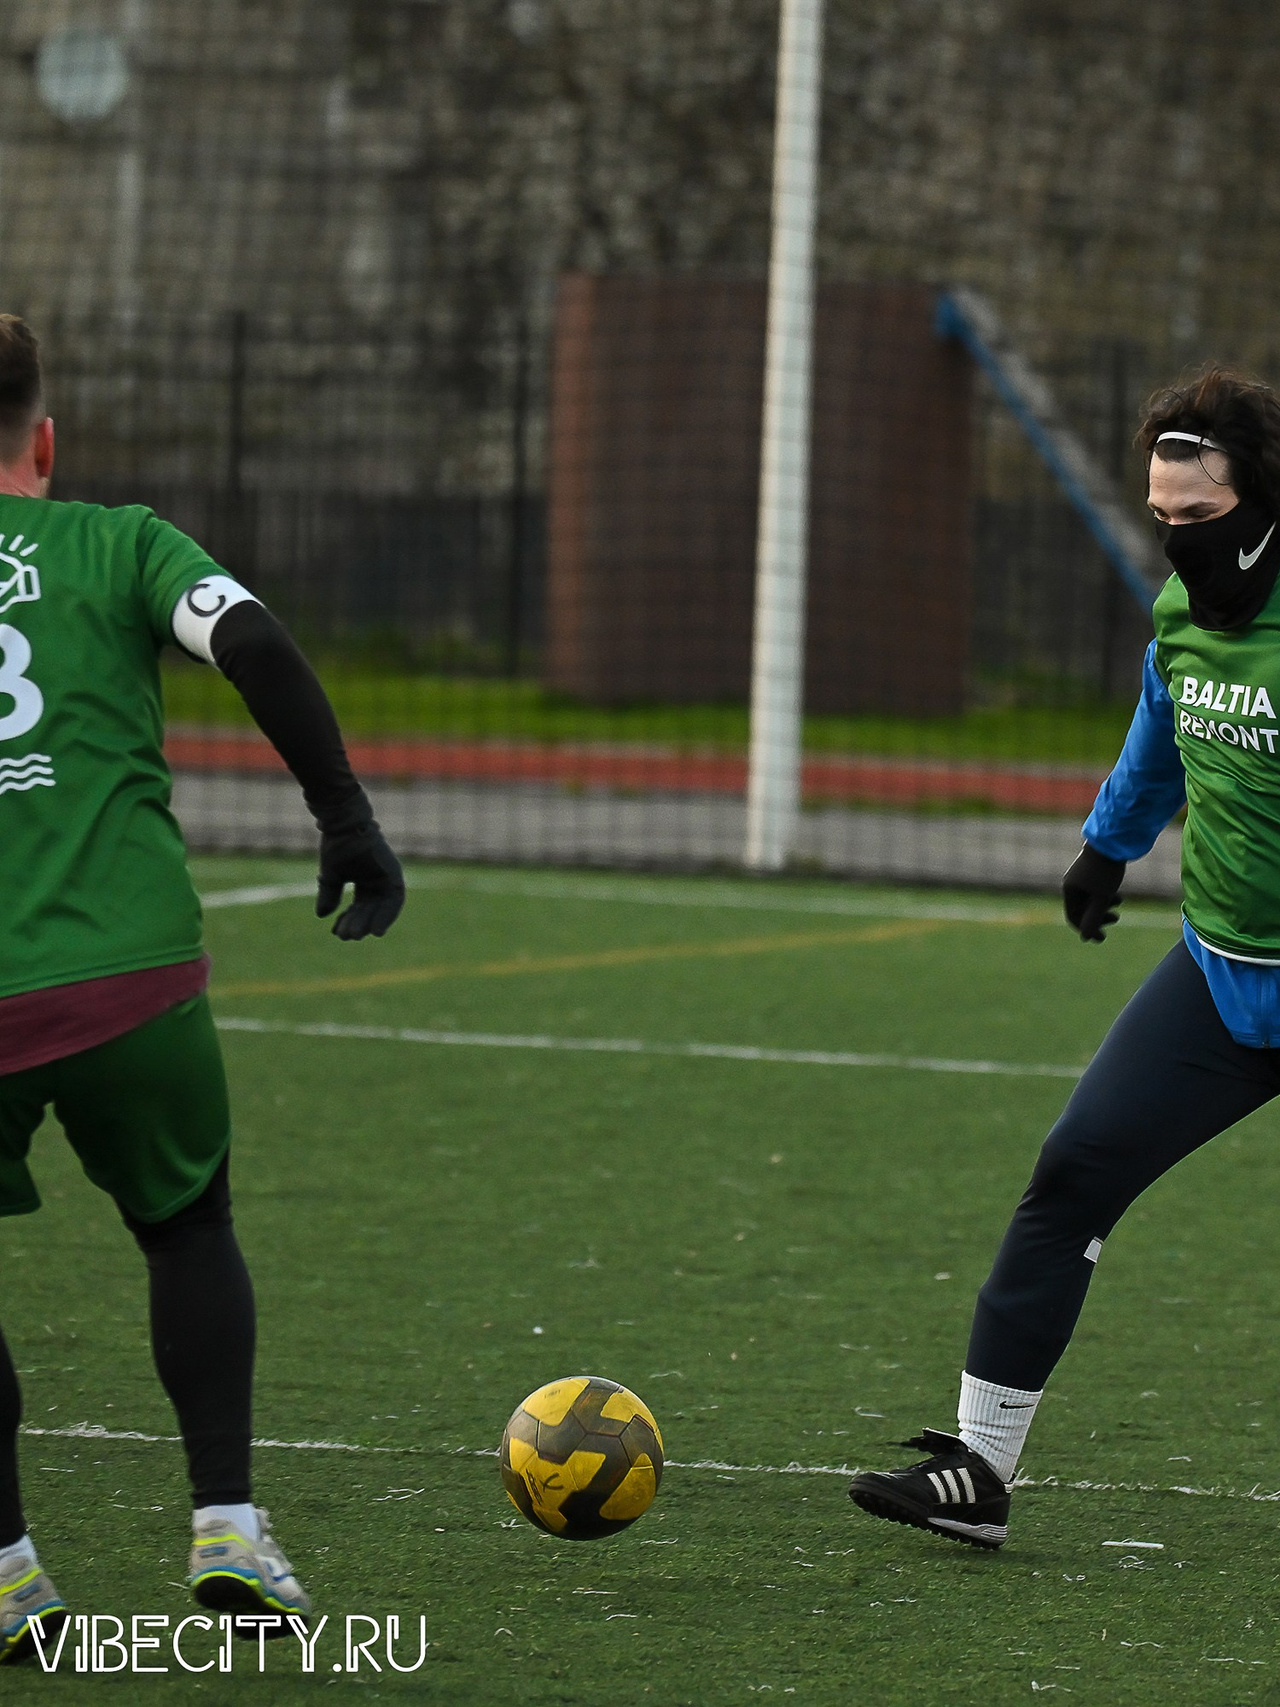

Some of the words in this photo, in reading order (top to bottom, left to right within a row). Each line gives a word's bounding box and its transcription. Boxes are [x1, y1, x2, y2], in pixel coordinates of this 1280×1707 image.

[187, 583, 226, 618] C
[1178, 676, 1277, 719] BALTIA
[1180, 710, 1279, 754] REMONT
